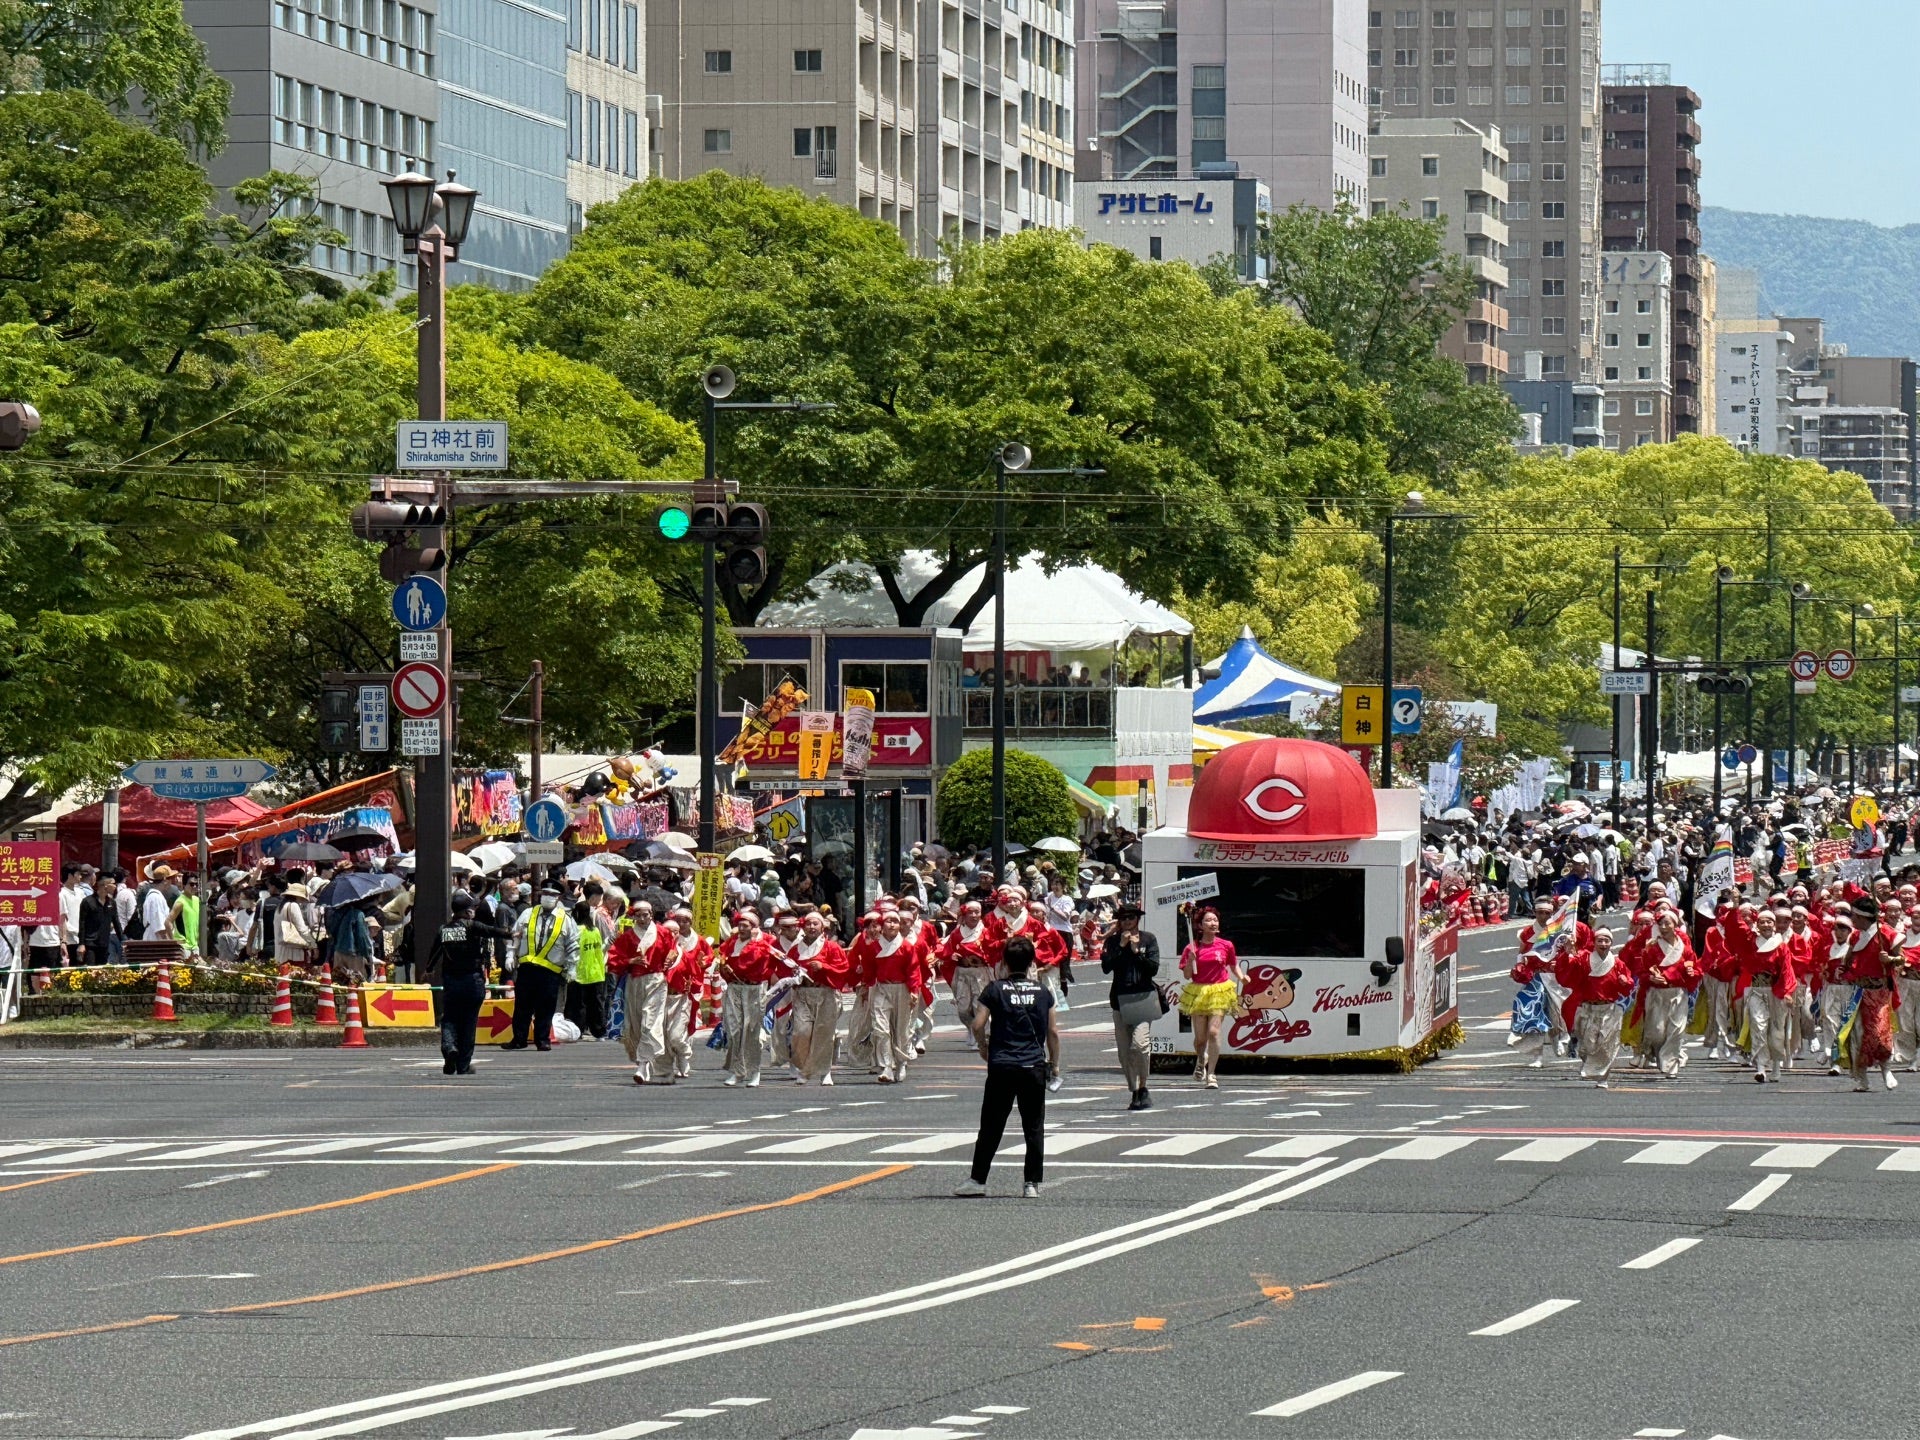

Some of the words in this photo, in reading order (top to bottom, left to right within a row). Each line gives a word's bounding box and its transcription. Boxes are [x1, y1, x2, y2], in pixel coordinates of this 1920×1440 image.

[1098, 192, 1213, 214] アサヒホーム
[410, 428, 495, 448] 白神社前
[406, 451, 464, 462] Shirakamisha
[470, 451, 498, 462] Shrine
[1831, 658, 1849, 671] 50
[1356, 695, 1371, 735] 白神
[154, 766, 243, 779] 鯉城通り
[767, 809, 799, 841] か
[1215, 850, 1350, 863] フラワーフェスティバル
[2, 857, 53, 873] 光物産
[1, 874, 54, 886] ーマーケット
[1010, 994, 1035, 1005] STAFF
[1312, 984, 1393, 1013] Hiroshima
[1228, 1017, 1312, 1053] Carp
